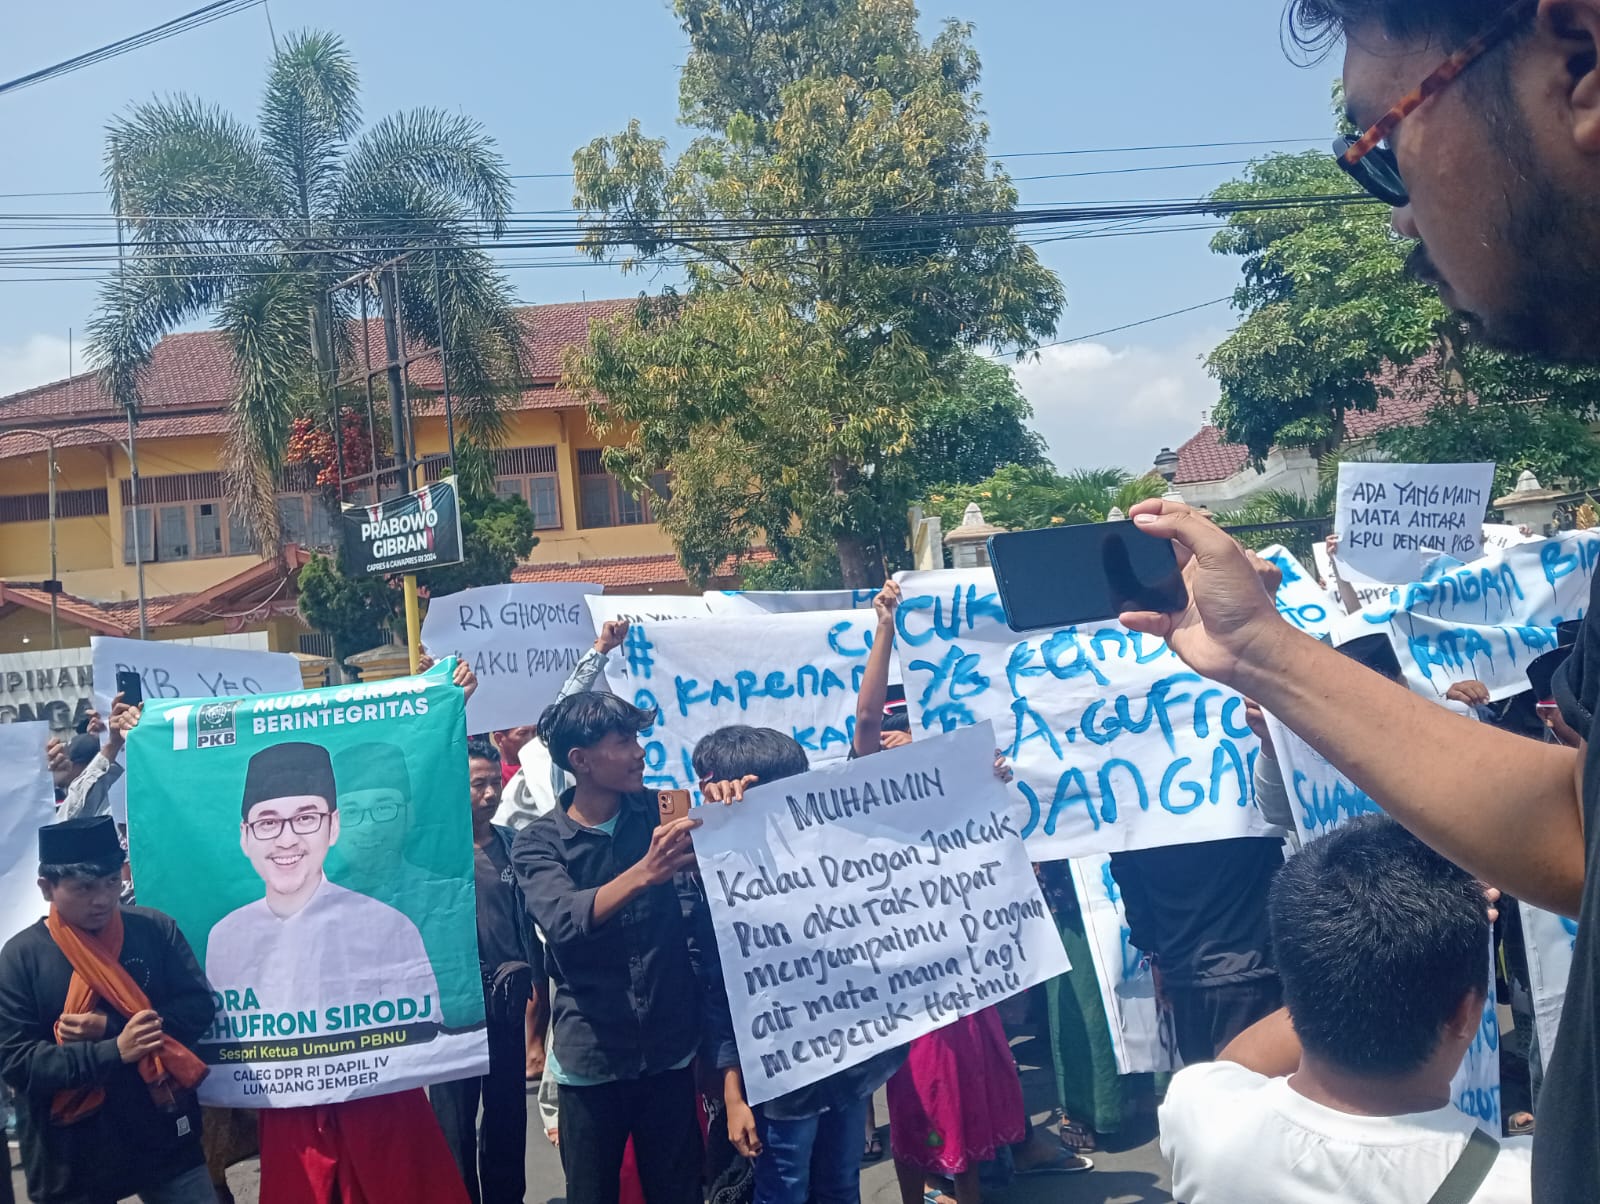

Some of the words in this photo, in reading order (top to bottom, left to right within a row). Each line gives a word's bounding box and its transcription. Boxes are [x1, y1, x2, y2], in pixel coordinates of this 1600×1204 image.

[1352, 482, 1387, 505] ADA
[1393, 480, 1440, 507] YANG
[1442, 484, 1481, 506] MAIN
[361, 508, 438, 542] PRABOWO
[1351, 508, 1400, 526] MATA
[1407, 510, 1466, 531] ANTARA
[372, 530, 428, 559] GIBRAN
[1349, 529, 1384, 549] KPU
[1392, 532, 1446, 552] DENGAN
[1451, 533, 1476, 554] PKB
[366, 561, 386, 573] CAPRES
[460, 604, 493, 631] RA
[474, 651, 519, 677] AKU
[163, 704, 194, 750] 1
[253, 697, 429, 735] BERINTEGRITAS
[198, 732, 235, 748] PKB
[785, 767, 945, 831] MUHAIMIN
[716, 865, 816, 908] Kalau
[818, 846, 922, 892] Dengan
[325, 994, 432, 1030] SIRODJ
[751, 1000, 798, 1040] air
[802, 979, 880, 1022] mata
[888, 957, 963, 995] mana
[219, 1045, 257, 1062] Sespri
[260, 1045, 299, 1060] Ketua
[303, 1038, 355, 1056] Umum
[360, 1029, 407, 1049] PBNU
[233, 1069, 271, 1082] CALEG
[275, 1066, 303, 1080] DPR
[307, 1064, 320, 1077] RI
[325, 1058, 370, 1076] DAPIL
[374, 1055, 389, 1069] IV
[243, 1079, 315, 1095] LUMAJANG
[318, 1071, 379, 1090] JEMBER
